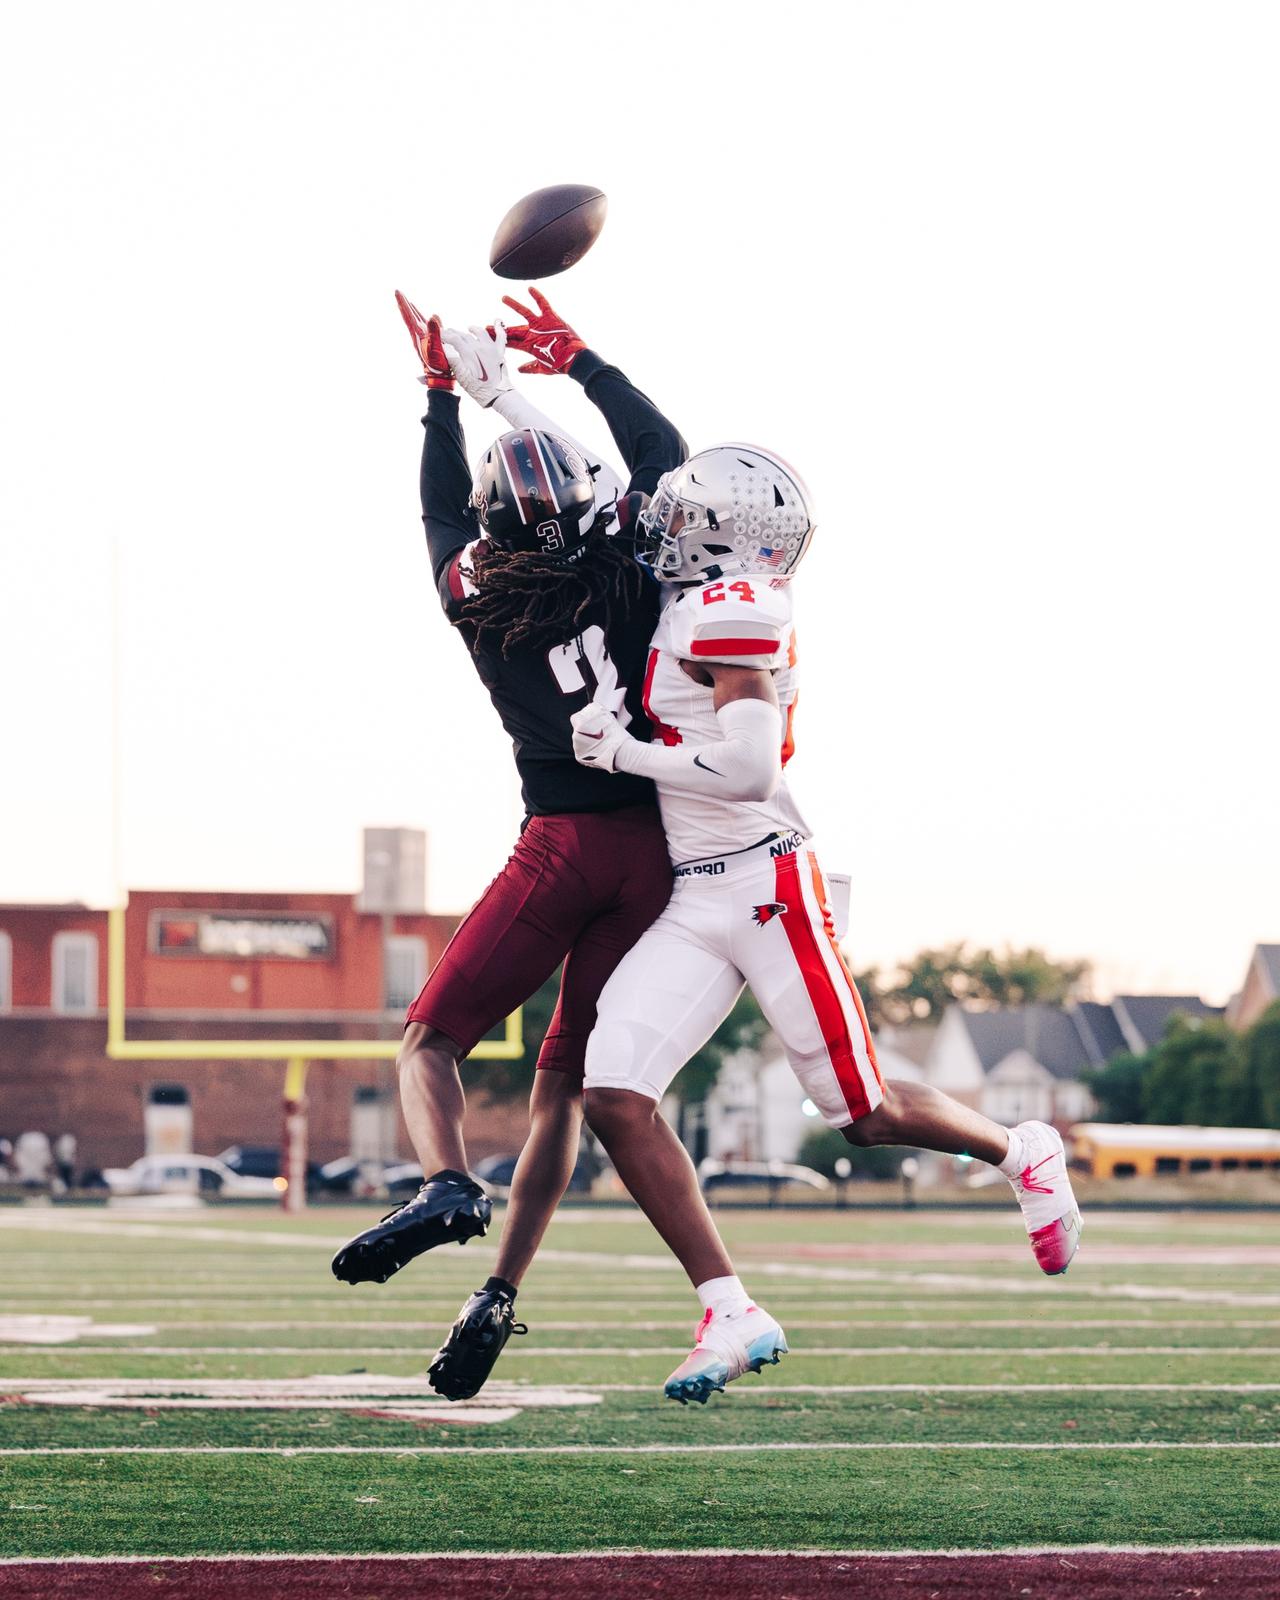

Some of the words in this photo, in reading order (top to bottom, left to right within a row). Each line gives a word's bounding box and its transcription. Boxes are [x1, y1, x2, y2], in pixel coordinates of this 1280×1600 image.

[536, 519, 565, 553] 3
[702, 582, 755, 606] 24
[769, 832, 802, 858] NIKE
